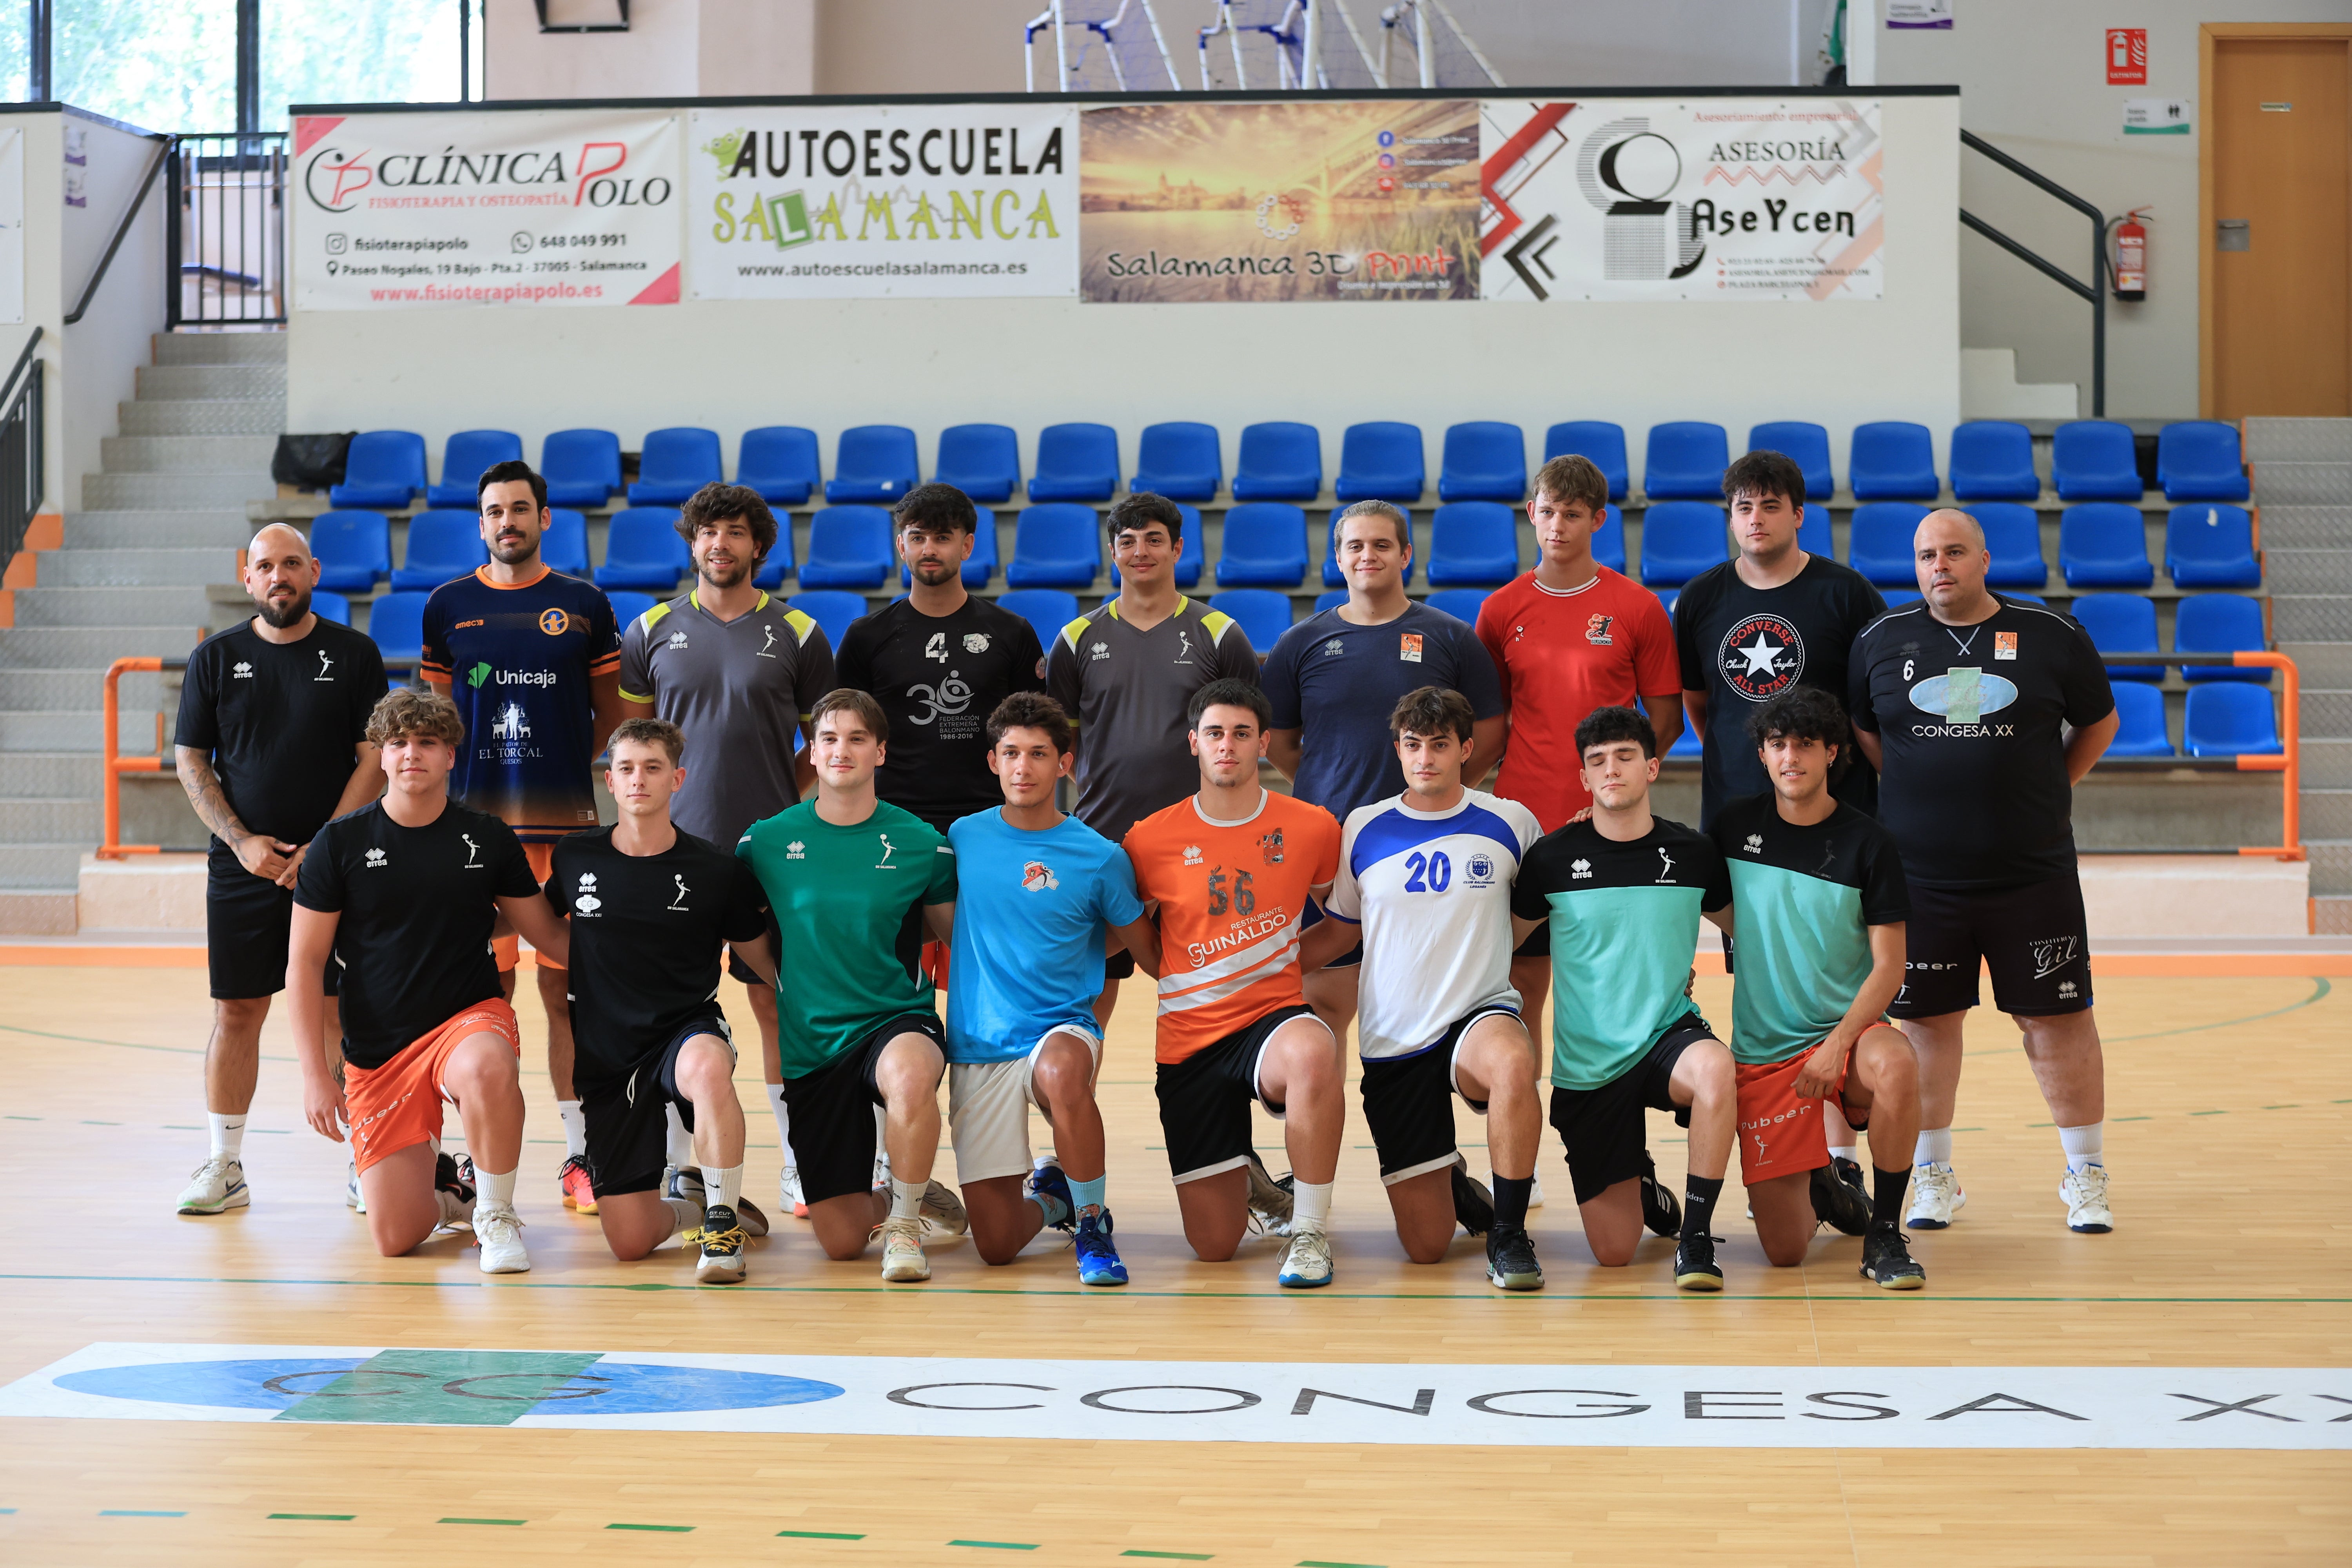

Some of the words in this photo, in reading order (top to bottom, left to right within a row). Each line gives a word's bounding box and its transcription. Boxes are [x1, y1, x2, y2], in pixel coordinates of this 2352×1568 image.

[1789, 111, 1858, 125] empresarial
[730, 127, 1063, 178] AUTOESCUELA
[1708, 136, 1847, 162] ASESORÍA
[377, 146, 567, 186] CLÍNICA
[573, 142, 671, 207] POLO
[368, 196, 465, 209] FISIOTERAPIA
[467, 195, 476, 207] Y
[480, 192, 569, 207] OSTEOPATÍA
[713, 188, 1060, 245] SALAMANCA
[1690, 198, 1855, 241] AseYcen
[354, 238, 468, 253] fisioterapiapolo
[540, 236, 566, 248] 648
[570, 235, 596, 247] 049
[600, 234, 627, 246] 991
[342, 265, 377, 276] Paseo
[381, 265, 434, 278] Nogales,
[437, 264, 451, 275] 19
[454, 263, 481, 277] Bajo
[580, 261, 647, 272] Salamanca
[737, 261, 1028, 276] www.autoescuelasalamanca.es
[1108, 250, 1296, 278] Salamanca
[1365, 245, 1455, 277] Print
[370, 282, 603, 303] www.fisioterapiapolo.es
[1730, 621, 1794, 647] CONVERSE
[925, 632, 949, 663] 4
[1092, 652, 1110, 661] errea
[1726, 659, 1749, 669] Chuck
[1773, 658, 1797, 670] Taylor
[1903, 659, 1915, 681] 6
[495, 669, 556, 689] Unicaja
[1733, 674, 1754, 693] ALL
[1758, 674, 1790, 694] STAR
[1912, 725, 1991, 737] CONGESA
[479, 749, 495, 759] EL
[497, 748, 543, 758] TORCAL
[1743, 845, 1761, 854] errea
[366, 858, 387, 867] errea
[1184, 856, 1204, 866] errea
[1404, 851, 1451, 893] 20
[1572, 870, 1592, 879] errea
[1208, 868, 1255, 916] 56
[1230, 906, 1284, 931] RESTAURANTE
[1187, 914, 1287, 968] GUINALDO
[2034, 935, 2077, 973] Gil
[2059, 991, 2078, 1000] errea
[886, 1381, 2092, 1421] CONGESA
